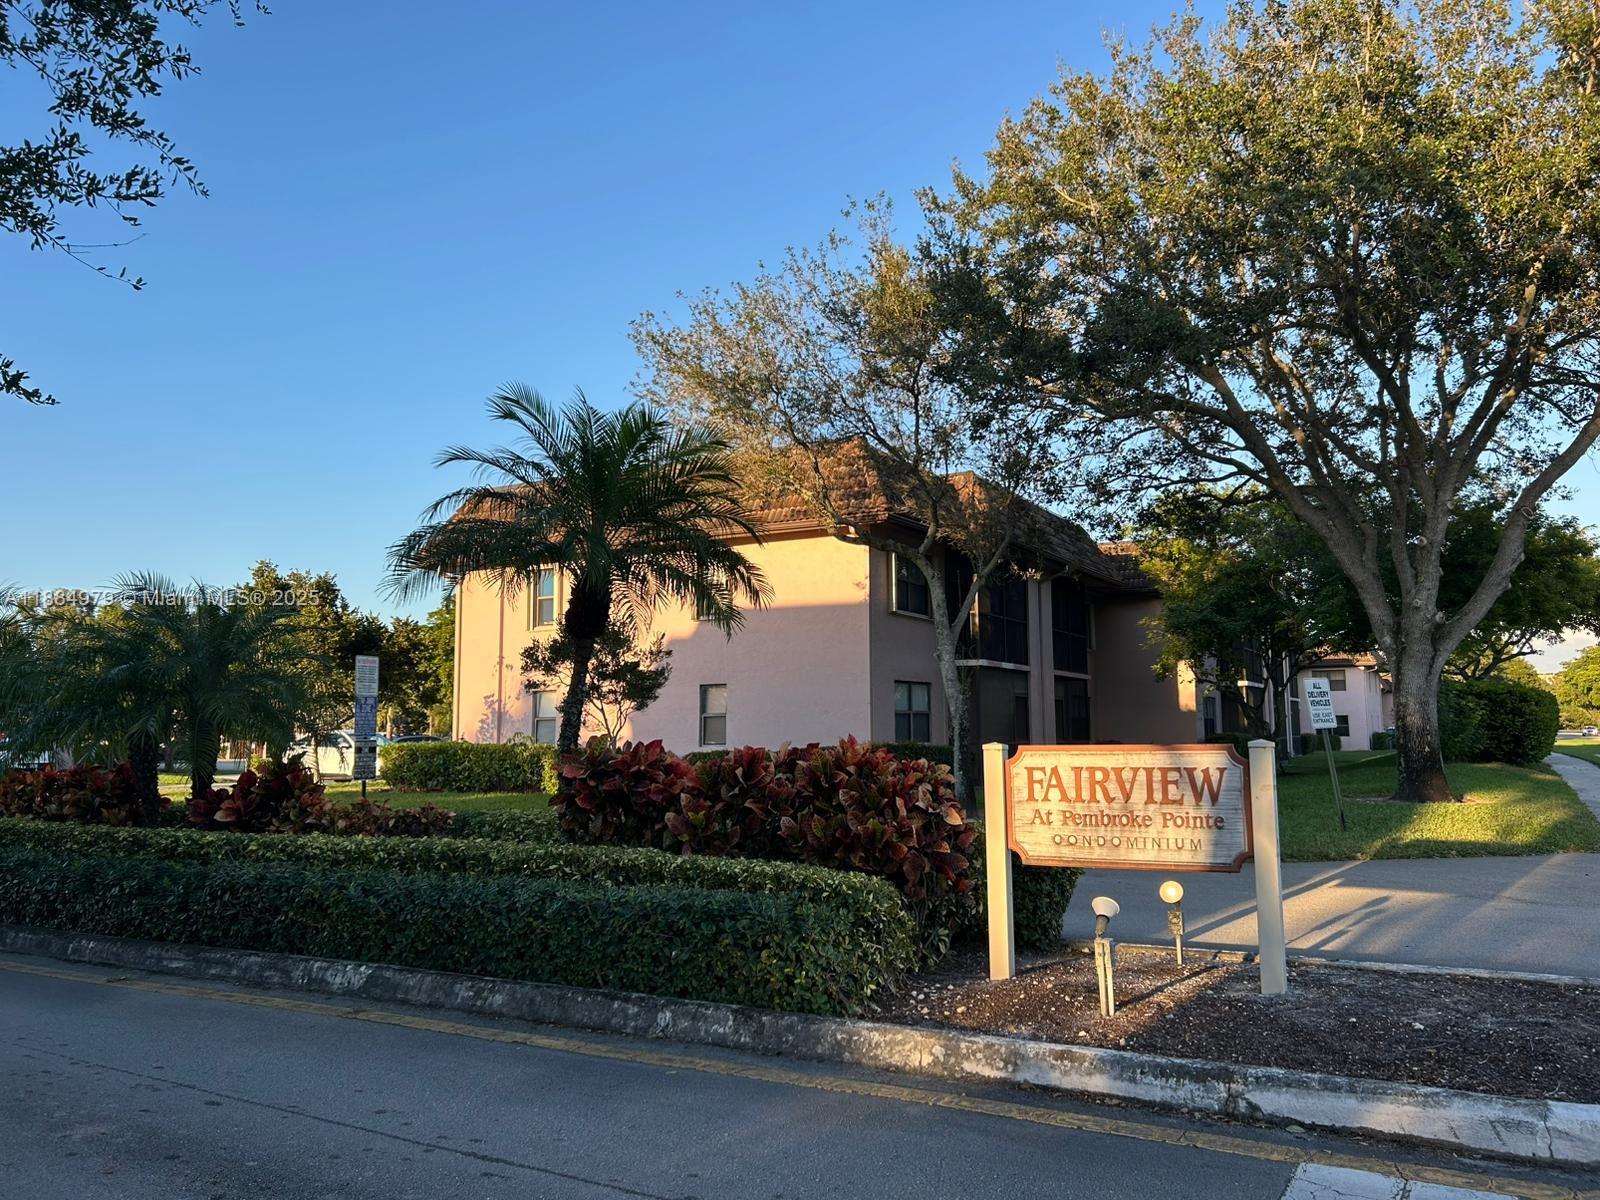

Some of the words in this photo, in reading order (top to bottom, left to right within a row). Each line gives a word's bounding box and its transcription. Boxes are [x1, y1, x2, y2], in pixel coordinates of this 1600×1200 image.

[1312, 682, 1322, 690] ALL
[1307, 691, 1329, 699] DELIVERY
[1310, 699, 1331, 707] VEHICLES
[1024, 765, 1228, 807] FAIRVIEW
[1031, 808, 1054, 826] At
[1061, 809, 1153, 829] Pembroke
[1162, 811, 1225, 830] Pointe
[1052, 833, 1203, 851] CONDOMINIUM
